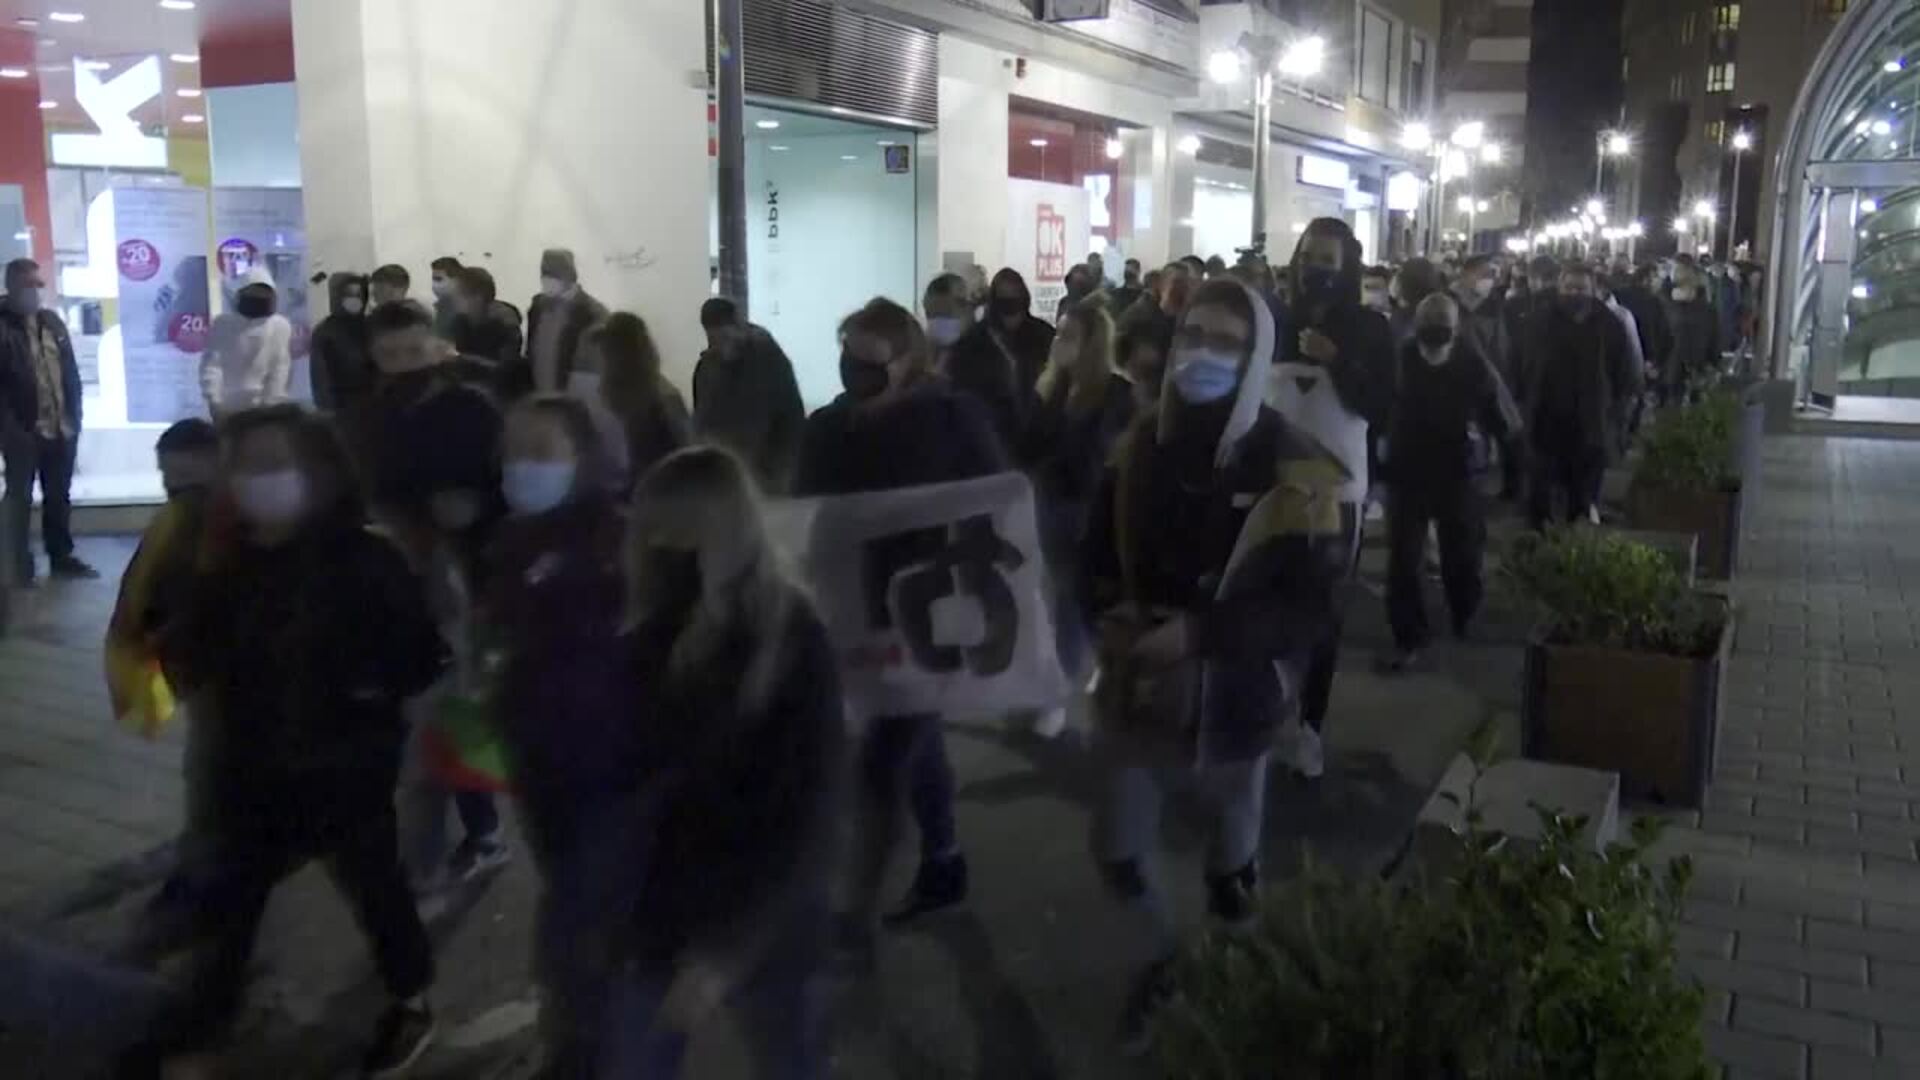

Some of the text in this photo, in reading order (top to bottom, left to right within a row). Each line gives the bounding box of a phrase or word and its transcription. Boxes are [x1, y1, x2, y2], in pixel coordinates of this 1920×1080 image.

[767, 190, 779, 239] bbk
[1038, 219, 1063, 256] OK
[1038, 257, 1063, 278] PLUS
